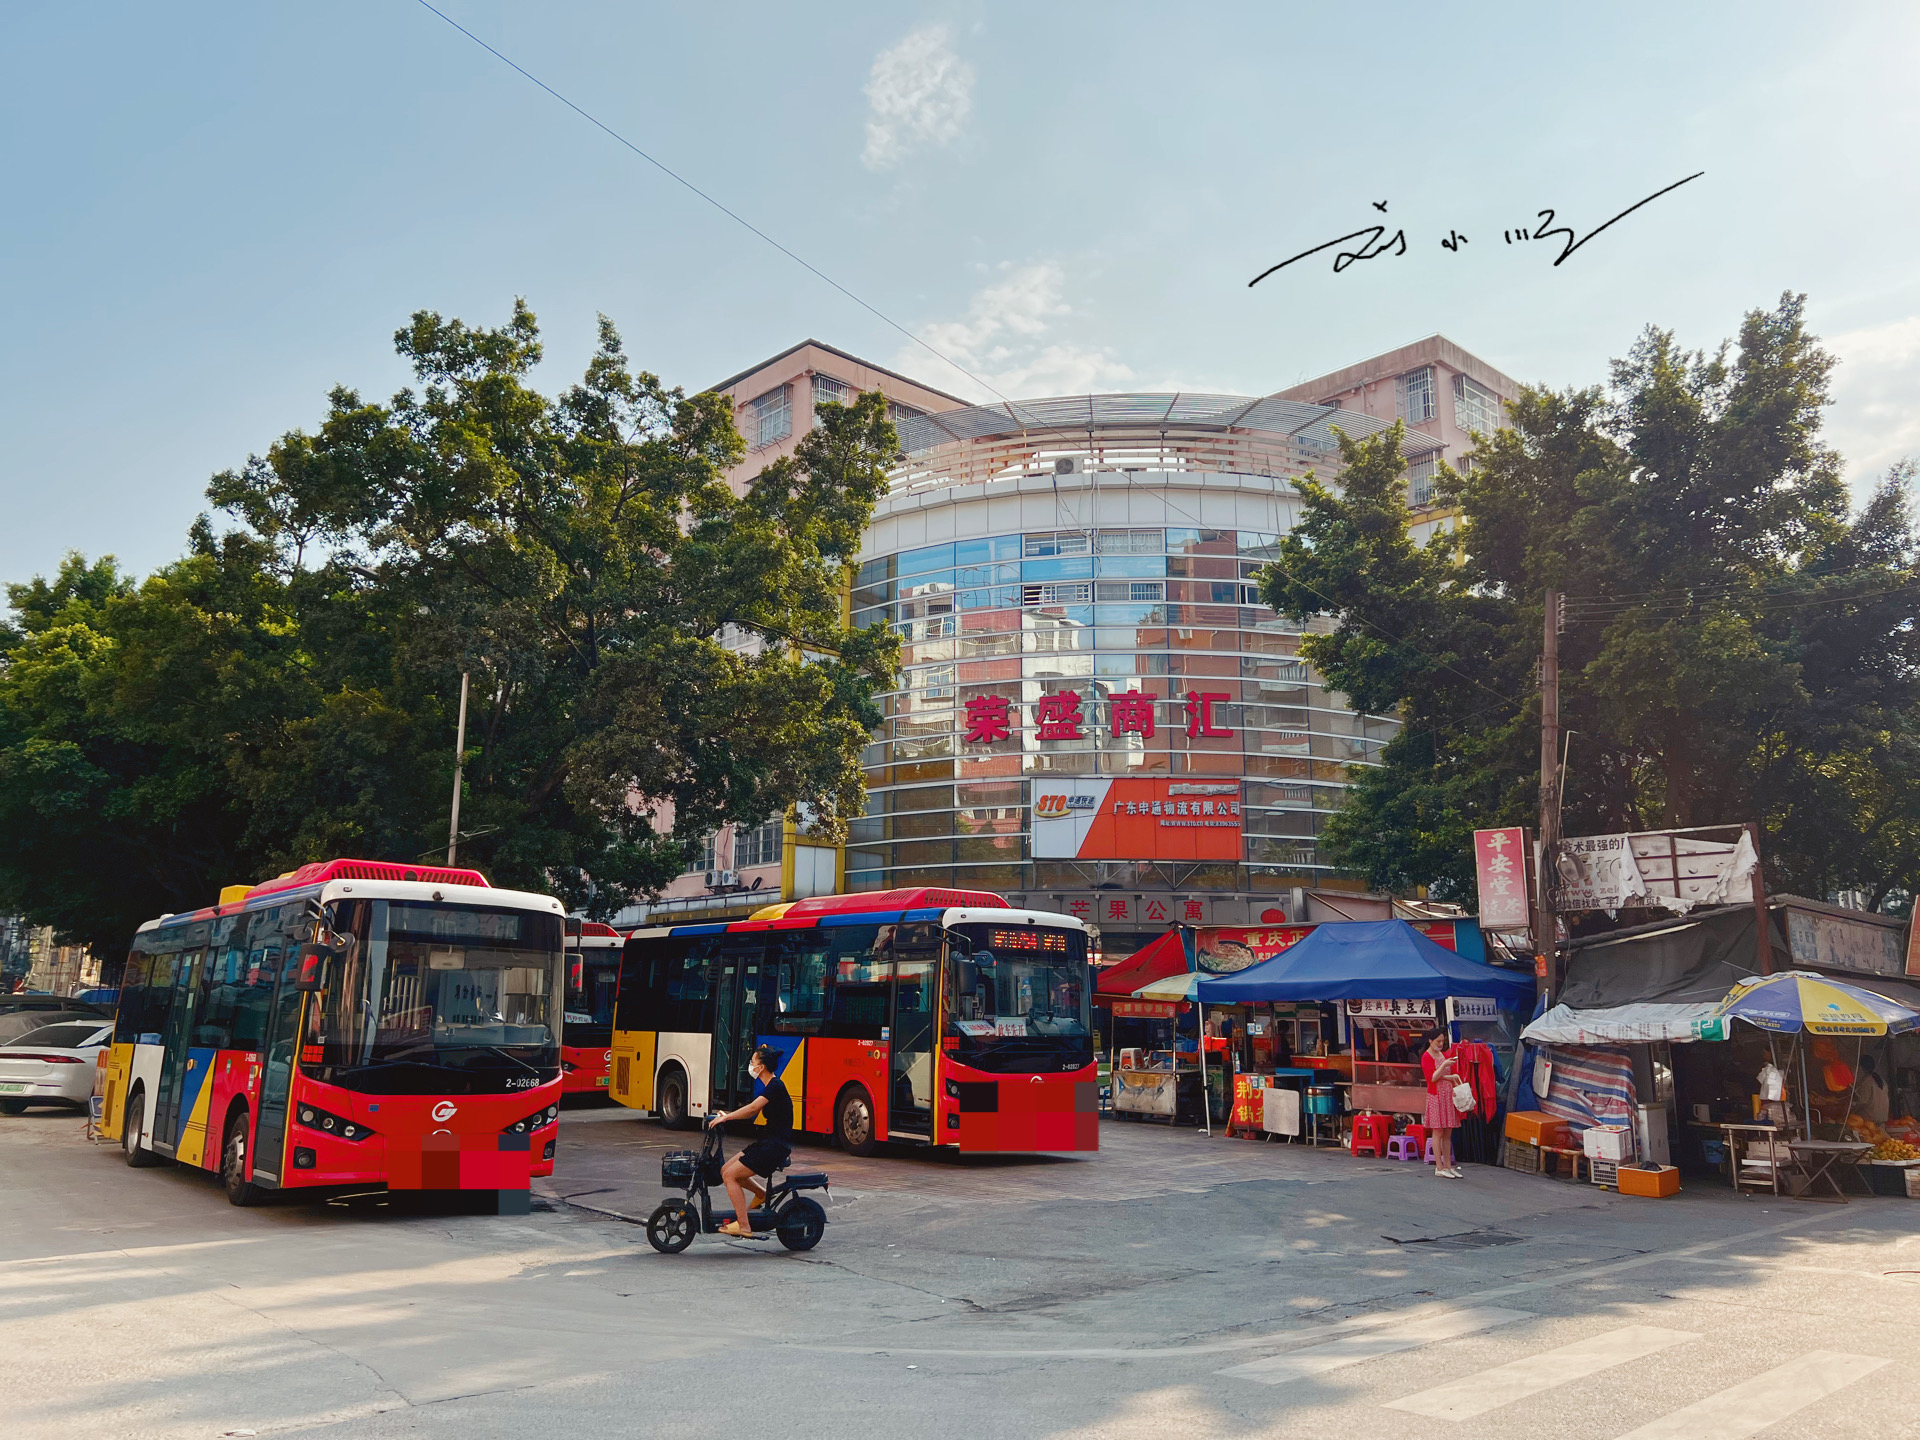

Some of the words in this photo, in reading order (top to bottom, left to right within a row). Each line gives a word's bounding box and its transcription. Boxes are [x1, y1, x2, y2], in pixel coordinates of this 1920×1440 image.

[964, 689, 1234, 744] 荣盛商汇
[1038, 795, 1067, 811] STO
[1113, 801, 1240, 816] 广东申通物流有限公司
[1487, 832, 1512, 897] 平安堂
[1070, 900, 1203, 920] 芒果公寓
